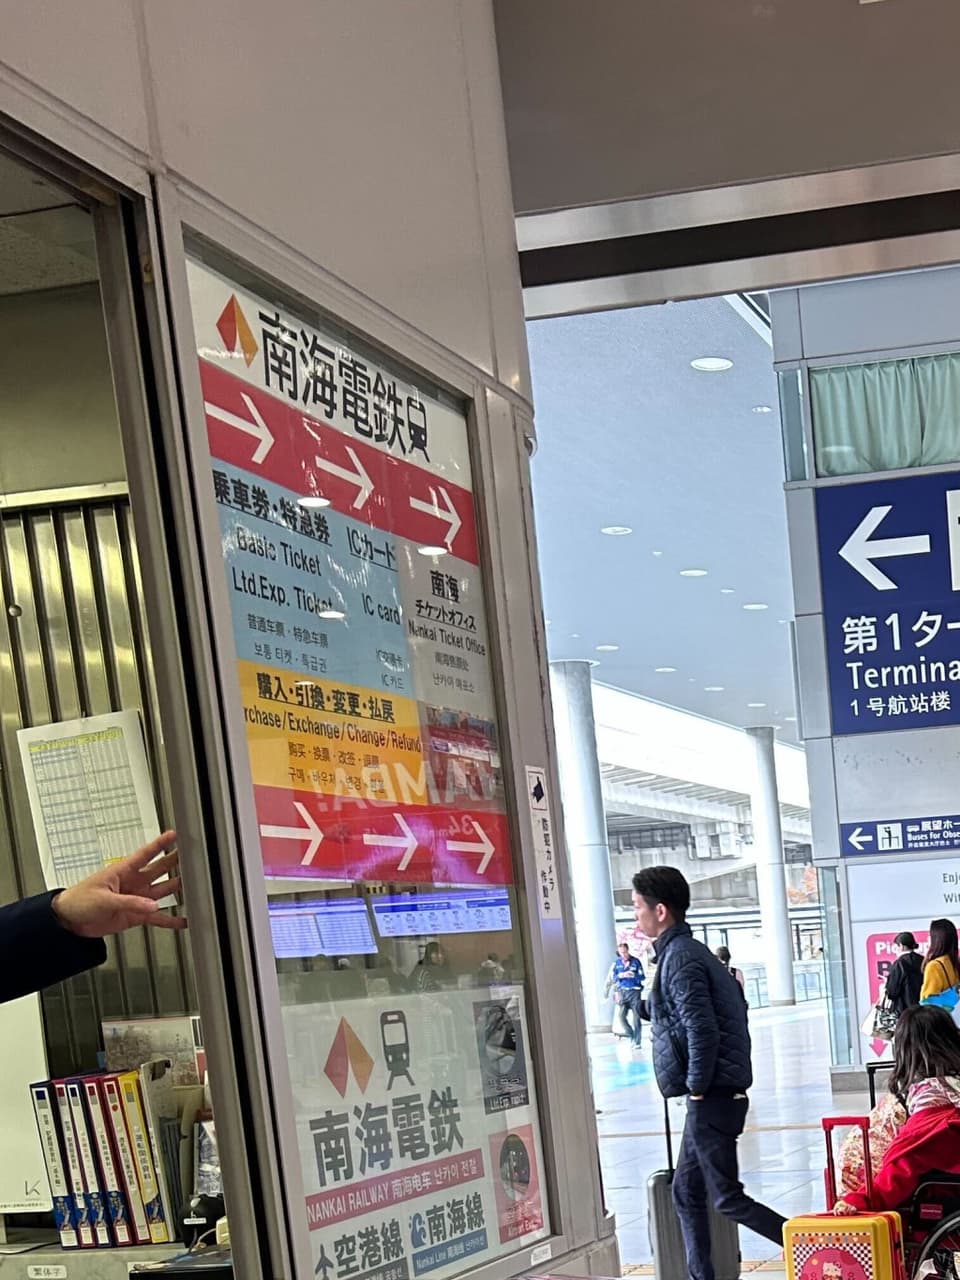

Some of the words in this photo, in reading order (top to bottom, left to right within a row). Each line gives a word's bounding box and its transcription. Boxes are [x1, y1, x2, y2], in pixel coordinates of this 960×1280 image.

[258, 311, 407, 455] 南海電鉄
[280, 541, 322, 577] Ticket
[430, 570, 460, 603] 南海
[361, 592, 374, 616] IC
[377, 602, 402, 626] card
[408, 618, 437, 642] Nankai
[439, 628, 464, 649] Ticket
[850, 691, 951, 716] 1号航站楼
[907, 831, 928, 841] Buses
[930, 831, 941, 839] for
[309, 1086, 464, 1187] 南海電鉄
[306, 1196, 347, 1225] NANKAI
[350, 1183, 390, 1212] RAILWAY
[426, 1191, 485, 1245] 南海線
[334, 1218, 404, 1278] 空港線
